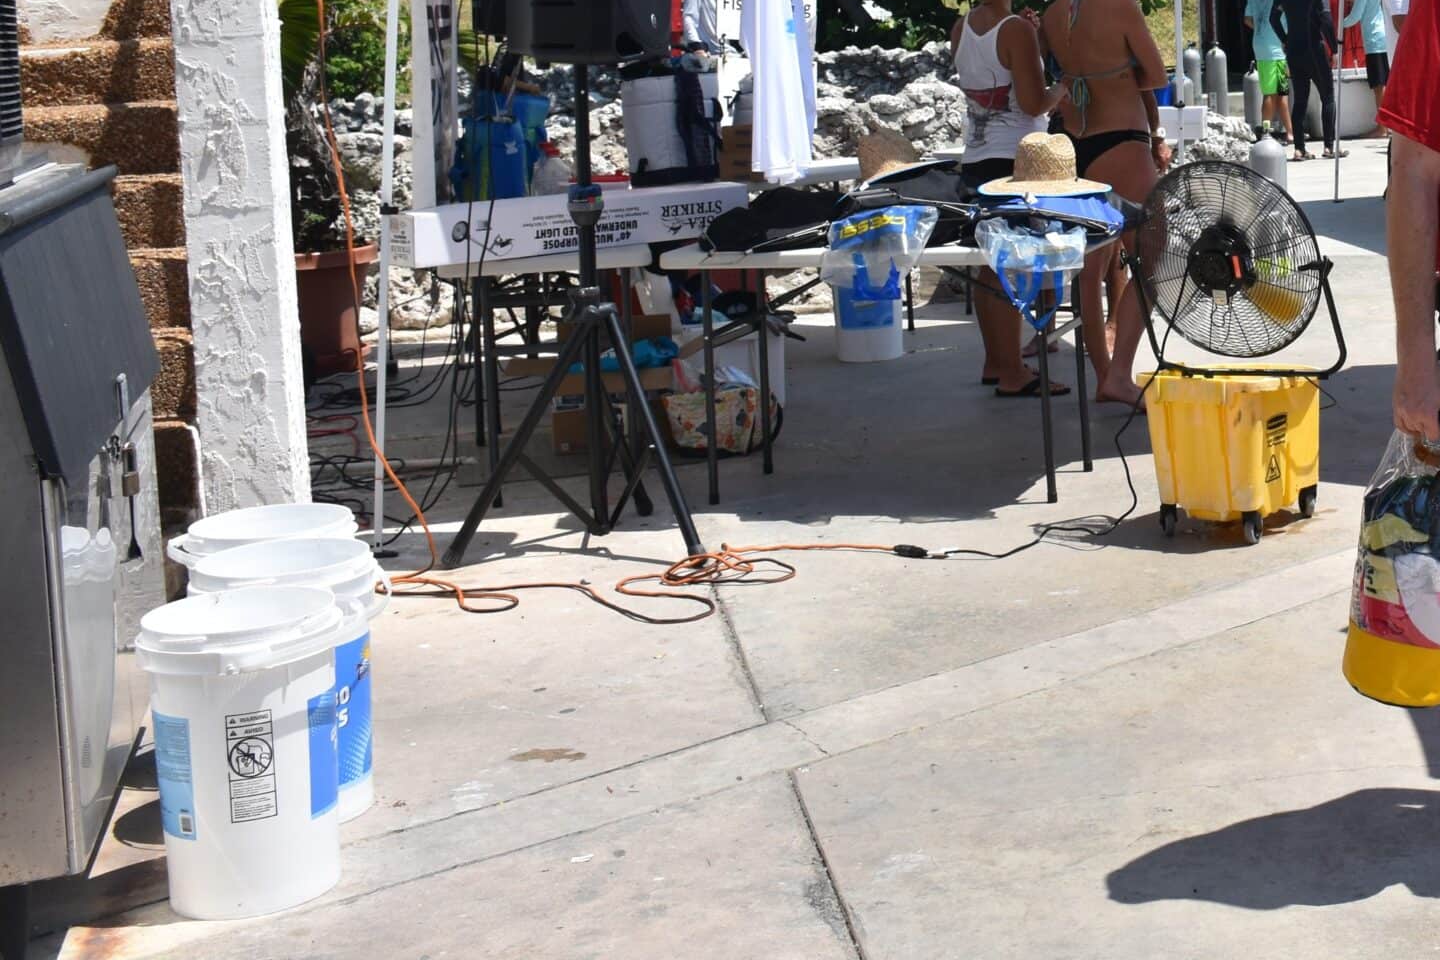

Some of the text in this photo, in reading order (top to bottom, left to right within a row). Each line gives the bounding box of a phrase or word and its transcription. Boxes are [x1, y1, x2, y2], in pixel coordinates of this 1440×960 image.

[660, 200, 722, 217] STRIKER
[535, 228, 561, 239] LIGHT
[563, 226, 579, 236] LED
